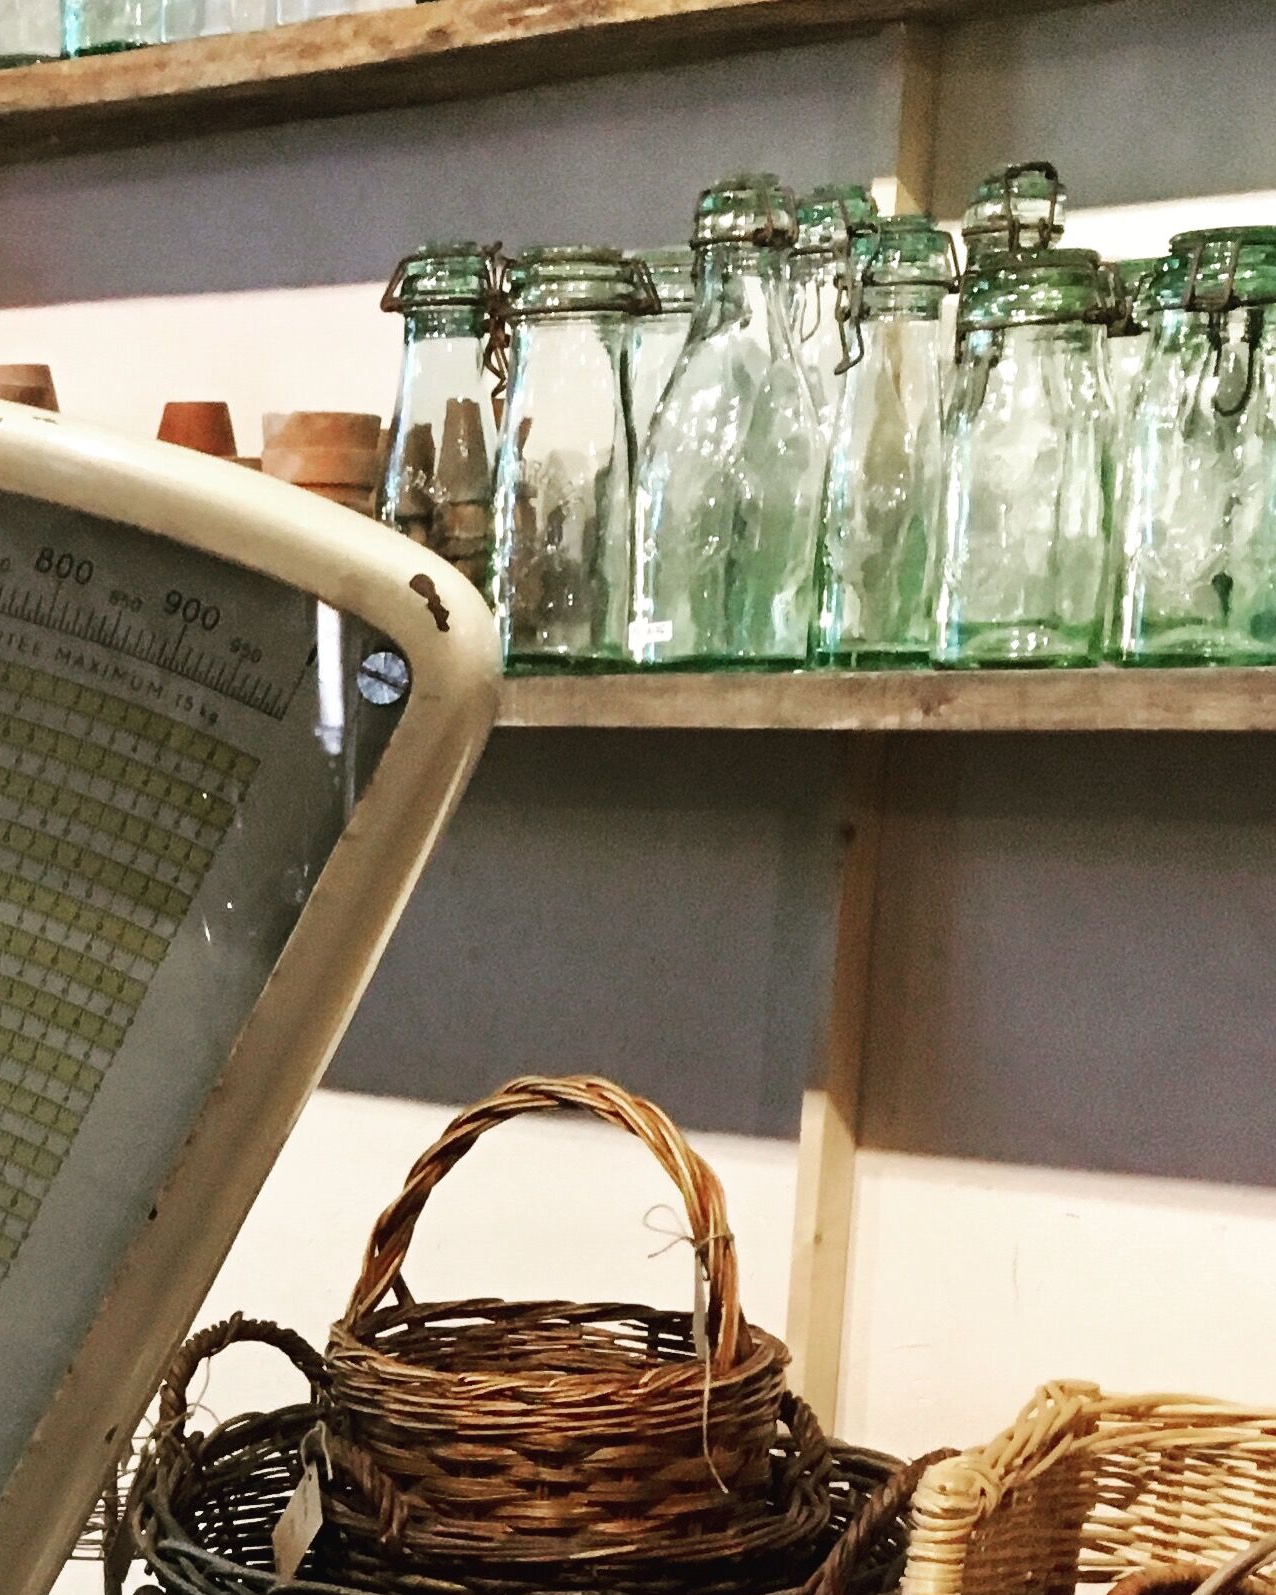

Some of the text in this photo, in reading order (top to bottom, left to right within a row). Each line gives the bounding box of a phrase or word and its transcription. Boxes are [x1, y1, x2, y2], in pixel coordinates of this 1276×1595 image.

[34, 547, 94, 586] 800
[164, 589, 222, 632] 900
[55, 646, 164, 700] MAXIMUM
